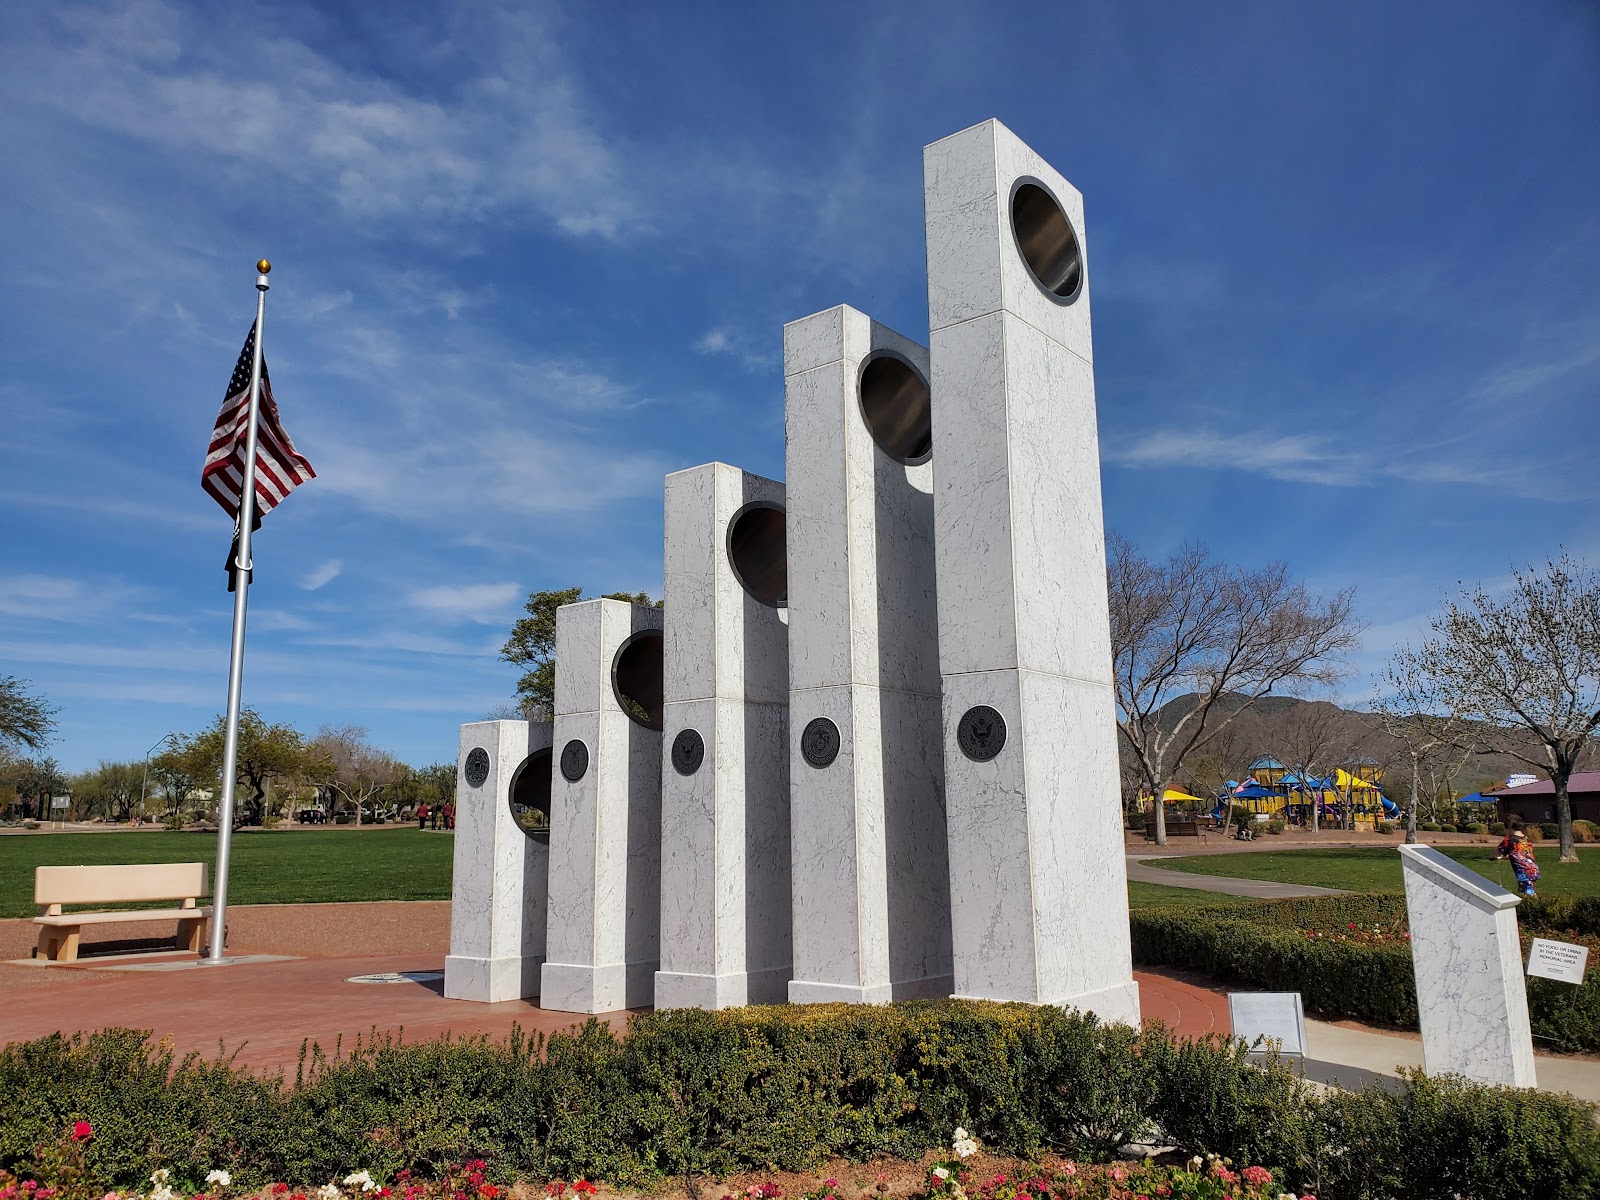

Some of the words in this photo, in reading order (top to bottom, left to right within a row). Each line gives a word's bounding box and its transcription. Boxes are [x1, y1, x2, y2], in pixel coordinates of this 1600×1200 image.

[961, 708, 981, 726] UNITED
[981, 708, 1001, 725] STATES
[972, 749, 994, 757] ARMY
[1539, 954, 1563, 962] MEMORIAL
[1554, 951, 1578, 959] VETERANS
